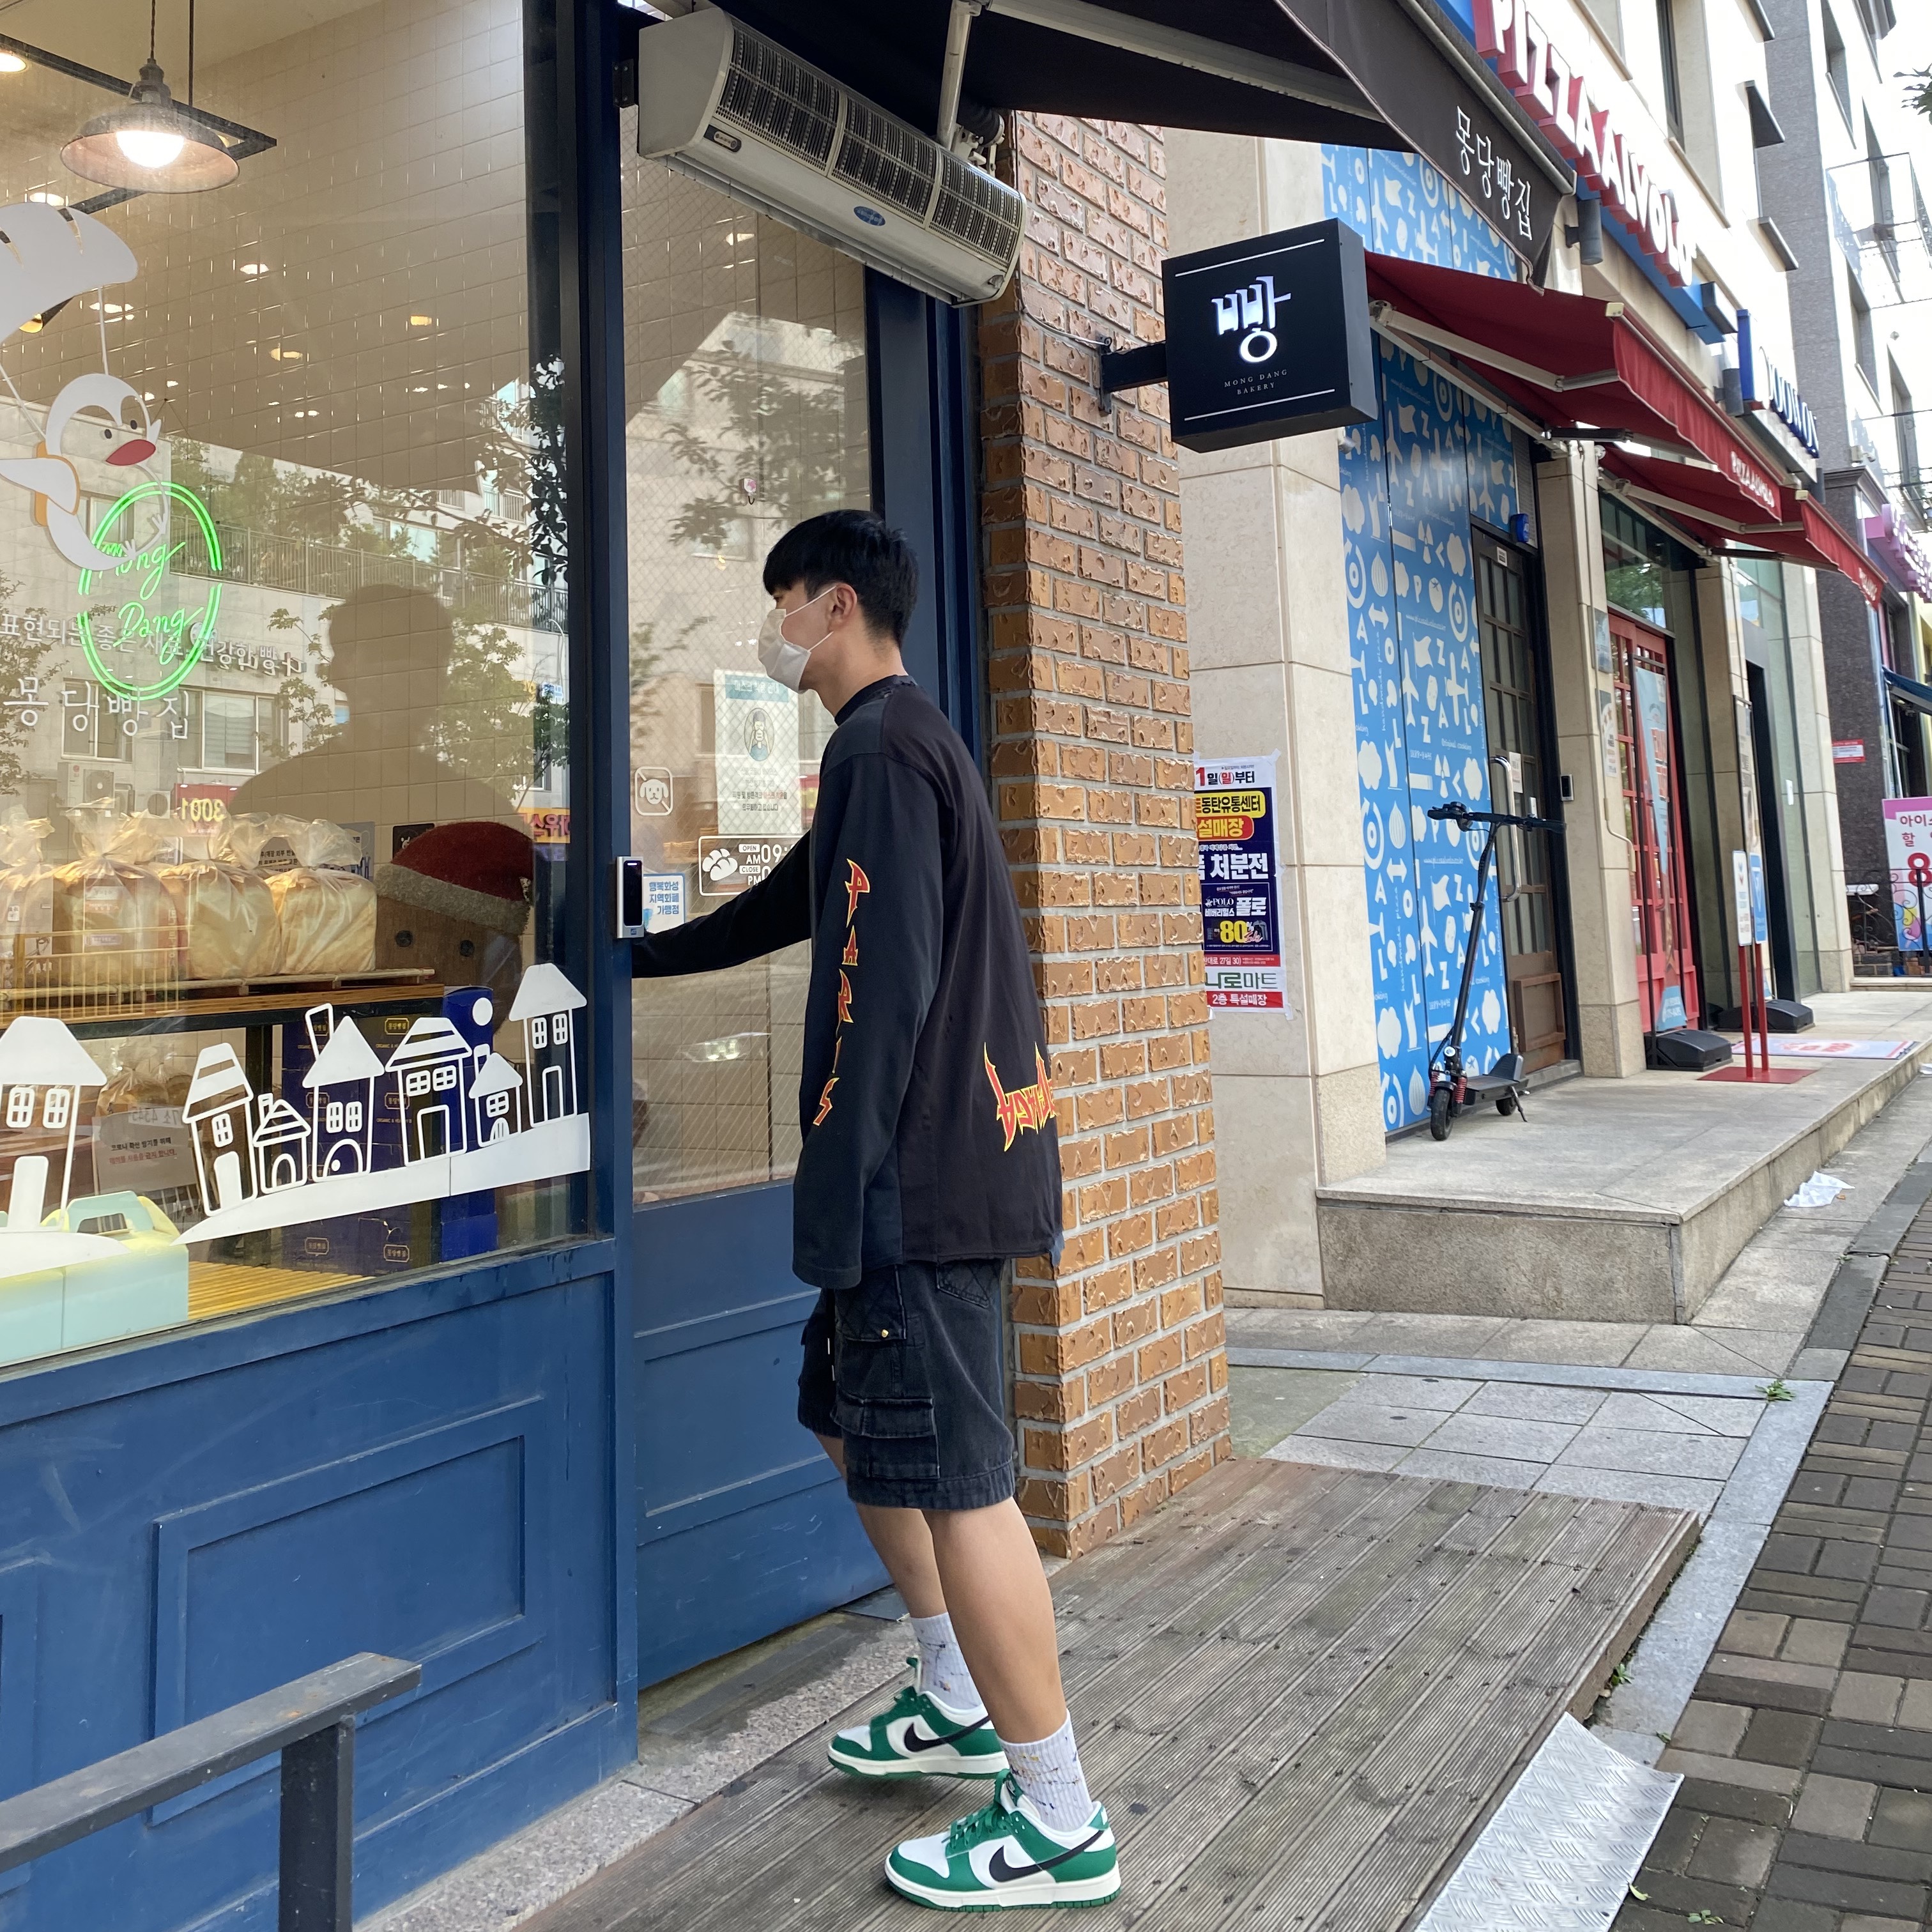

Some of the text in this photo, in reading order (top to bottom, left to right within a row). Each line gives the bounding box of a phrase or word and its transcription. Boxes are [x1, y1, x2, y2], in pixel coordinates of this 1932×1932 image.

[1456, 106, 1533, 240] 몽당빵집
[1211, 275, 1291, 363] 빵
[1224, 369, 1288, 388] MONG DANG
[1237, 382, 1276, 395] BAKERY
[113, 601, 204, 664] Dang
[5, 676, 189, 740] 몽당빵집
[746, 854, 761, 864] AM
[1210, 853, 1268, 880] 처분전
[649, 882, 678, 891] 행복화성
[747, 875, 761, 885] PM
[649, 893, 679, 903] 지역화폐
[657, 905, 679, 915] 가맹점
[1205, 908, 1234, 917] 비버리힐스
[1213, 897, 1266, 916] POLO 폴로
[1220, 956, 1232, 965] 27길
[1232, 956, 1241, 965] 30)
[813, 858, 870, 1126] PARIS
[1213, 993, 1267, 1006] 2층 특설매장
